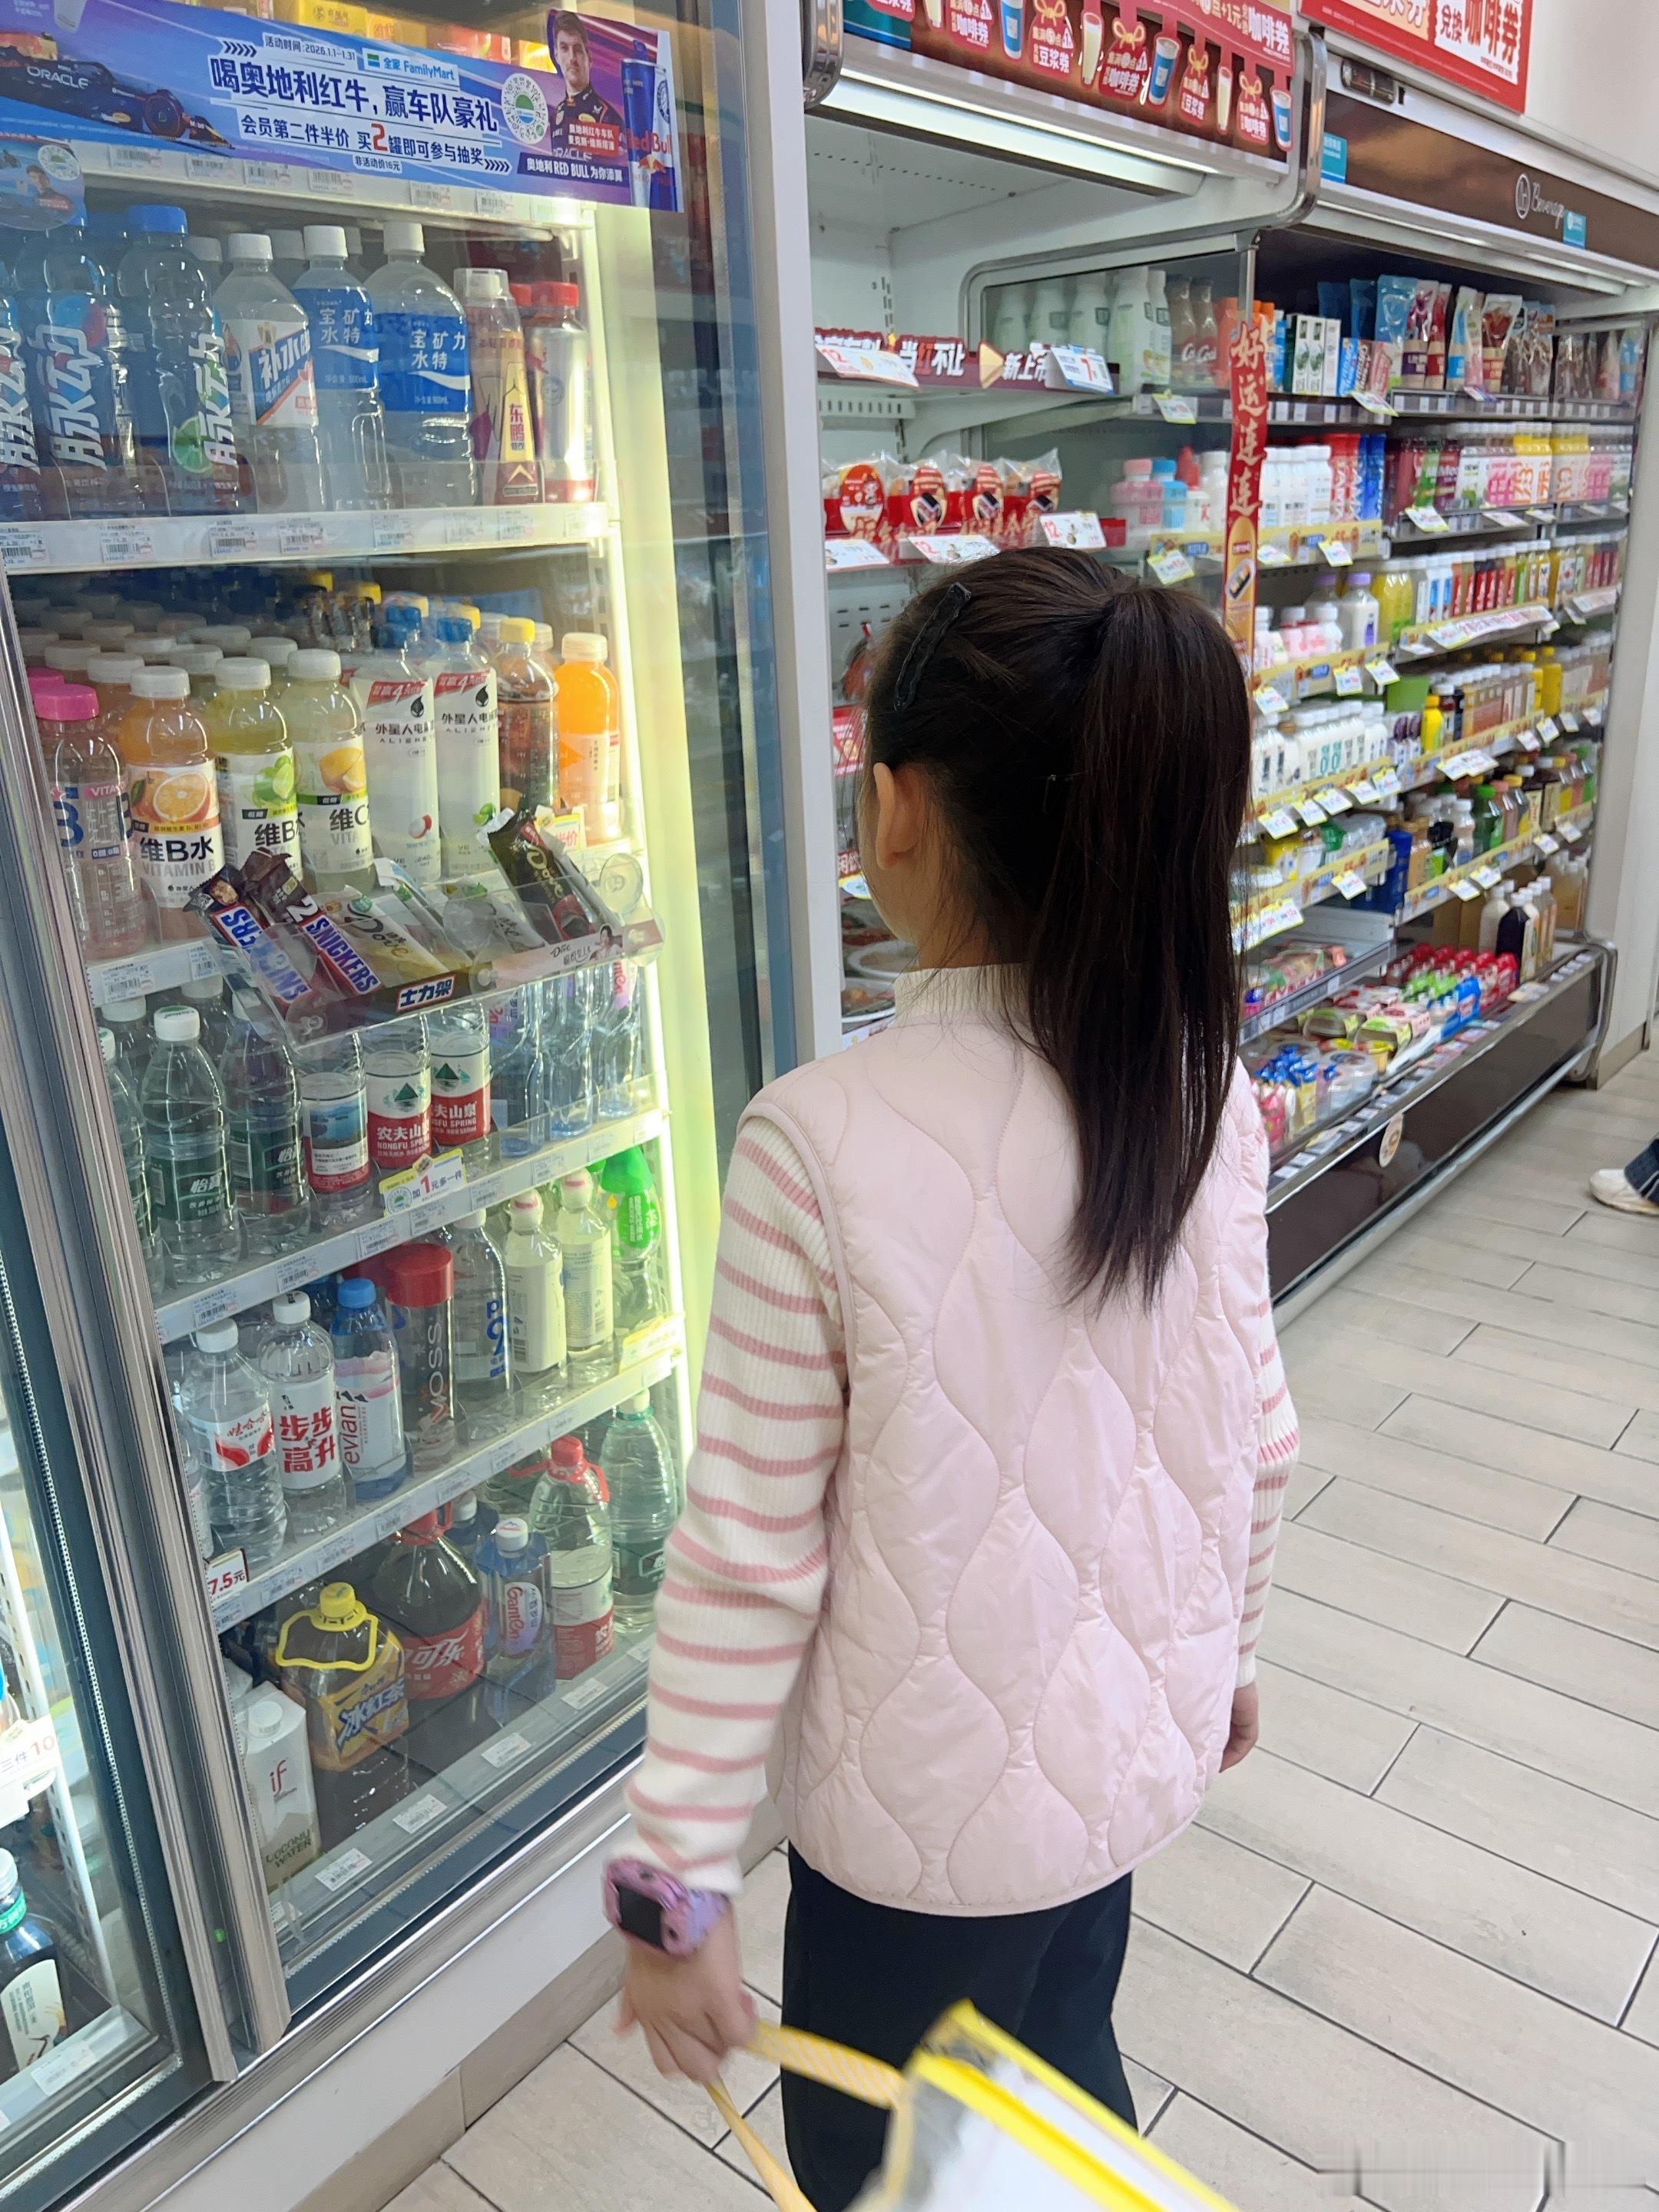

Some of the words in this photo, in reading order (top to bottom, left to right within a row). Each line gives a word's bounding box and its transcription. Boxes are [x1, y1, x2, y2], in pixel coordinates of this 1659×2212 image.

[27, 66, 90, 91] ORACLE
[404, 61, 456, 81] FamilyMart
[241, 114, 350, 148] 会员第二件半价
[357, 123, 483, 165] 买2罐即可参与抽奖
[651, 132, 672, 154] Bull
[553, 161, 570, 177] RED
[571, 163, 589, 179] BULL
[320, 308, 373, 326] 宝矿力
[321, 326, 360, 344] 水特
[409, 328, 466, 351] 宝矿力
[411, 350, 448, 370] 水特
[27, 325, 108, 472] 脉动
[188, 333, 240, 469] 脉动
[329, 804, 369, 832] 维C
[254, 820, 299, 847] 维B
[140, 835, 214, 863] 维B水
[142, 861, 205, 876] VITAMIN
[208, 859, 216, 872] B
[306, 916, 379, 992] SNICKERS
[400, 979, 453, 1007] 士力架
[431, 1101, 477, 1120] 夫山泉
[376, 1141, 409, 1151] NONGFU
[427, 1320, 445, 1419] VOSS
[279, 1406, 333, 1442] 步步
[339, 1404, 361, 1465] evian
[282, 1434, 336, 1474] 高升
[207, 1569, 245, 1596] 7.5元
[30, 1735, 55, 1757] 10
[270, 1759, 288, 1797] if
